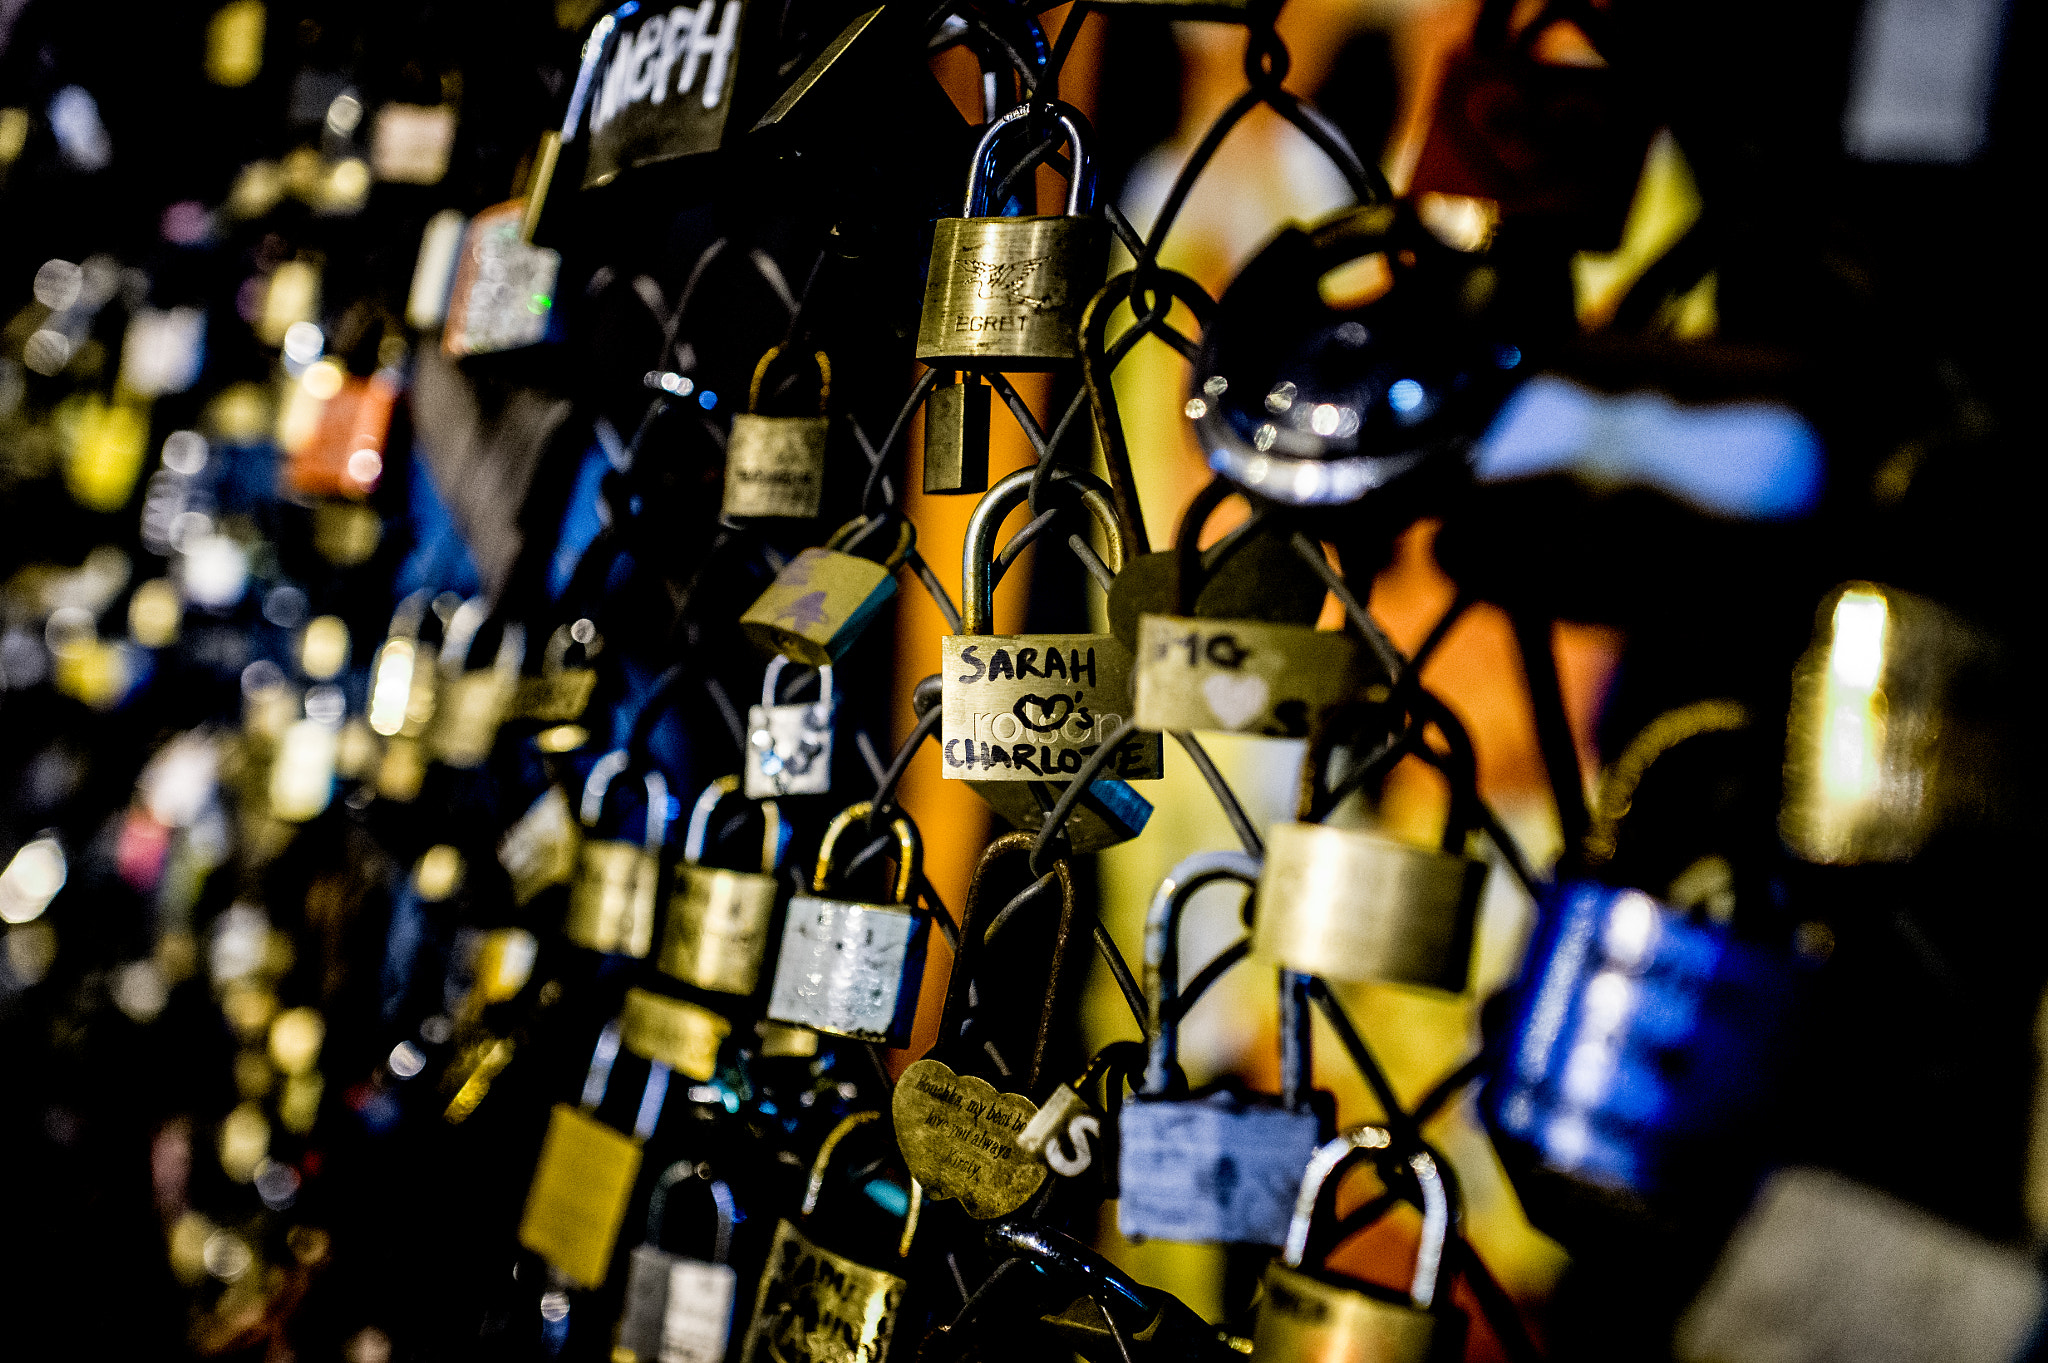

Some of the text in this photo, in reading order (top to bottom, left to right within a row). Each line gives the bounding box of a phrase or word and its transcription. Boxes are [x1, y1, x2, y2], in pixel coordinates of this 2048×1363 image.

[955, 315, 1027, 332] EGRET
[958, 645, 1096, 688] SARAH
[924, 1108, 1013, 1160] love you always
[965, 1099, 987, 1128] my
[986, 1102, 1013, 1127] best
[1045, 1115, 1101, 1178] S
